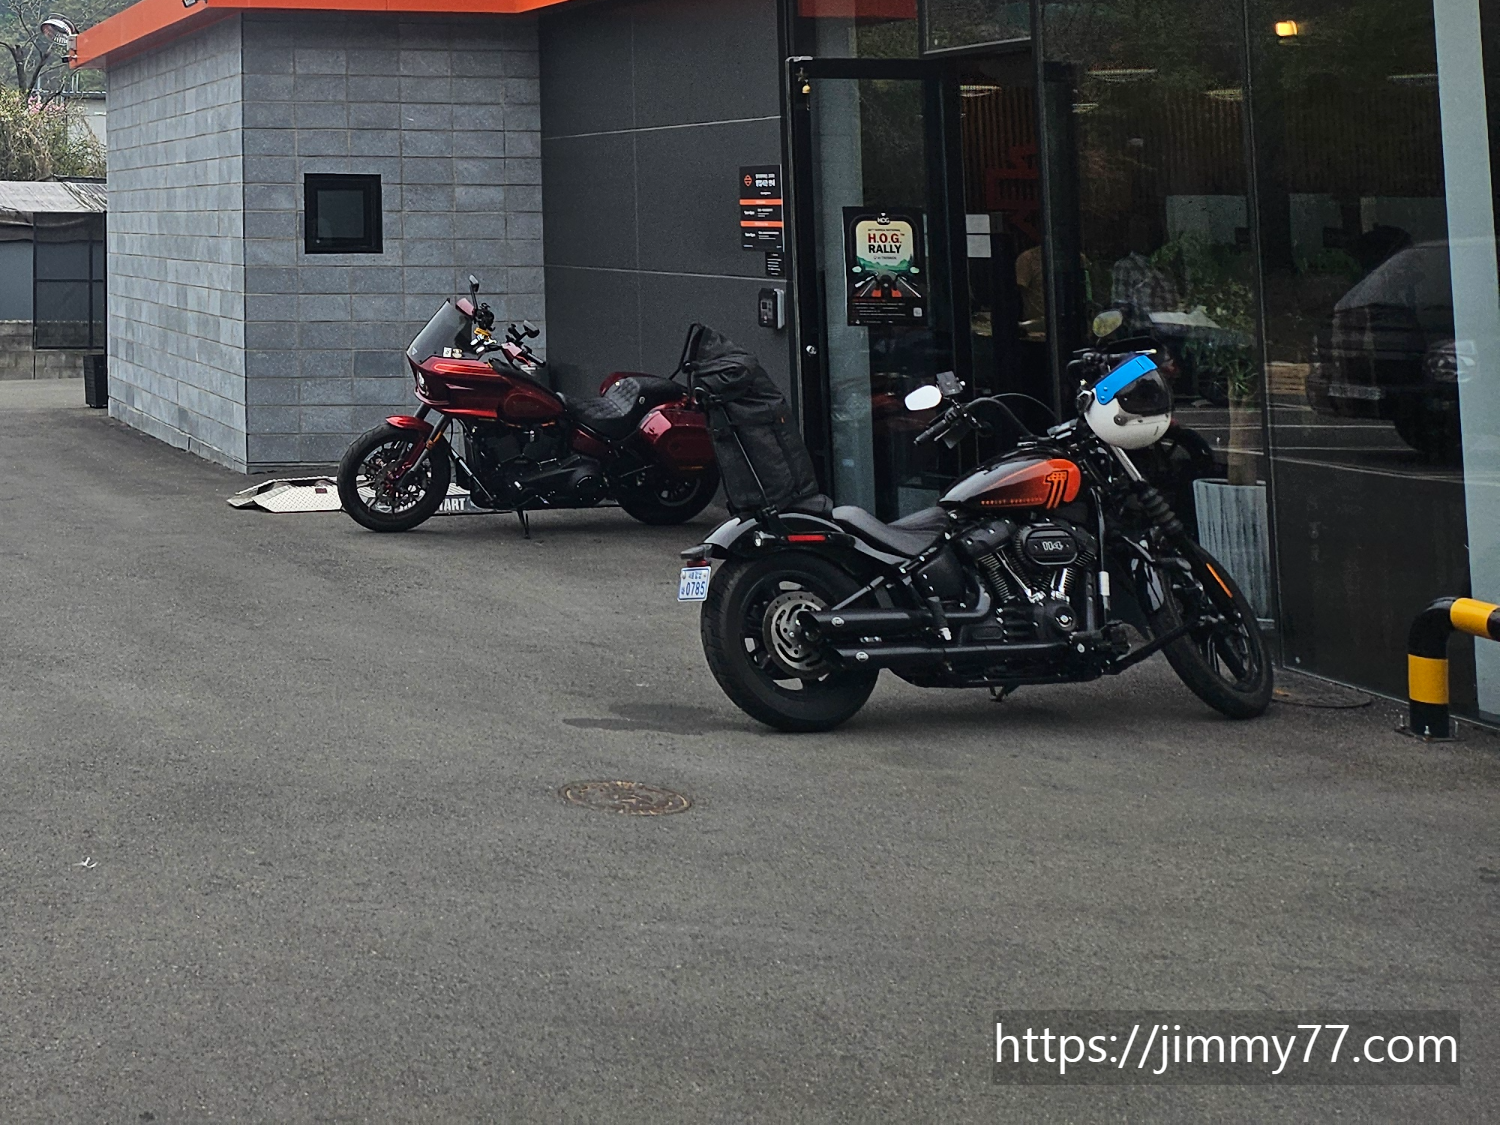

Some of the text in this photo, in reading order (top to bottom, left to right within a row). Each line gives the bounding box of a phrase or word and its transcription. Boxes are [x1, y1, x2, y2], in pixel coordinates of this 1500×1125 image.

[868, 244, 902, 254] RALLY
[1042, 540, 1064, 551] 114
[685, 580, 706, 596] 0785
